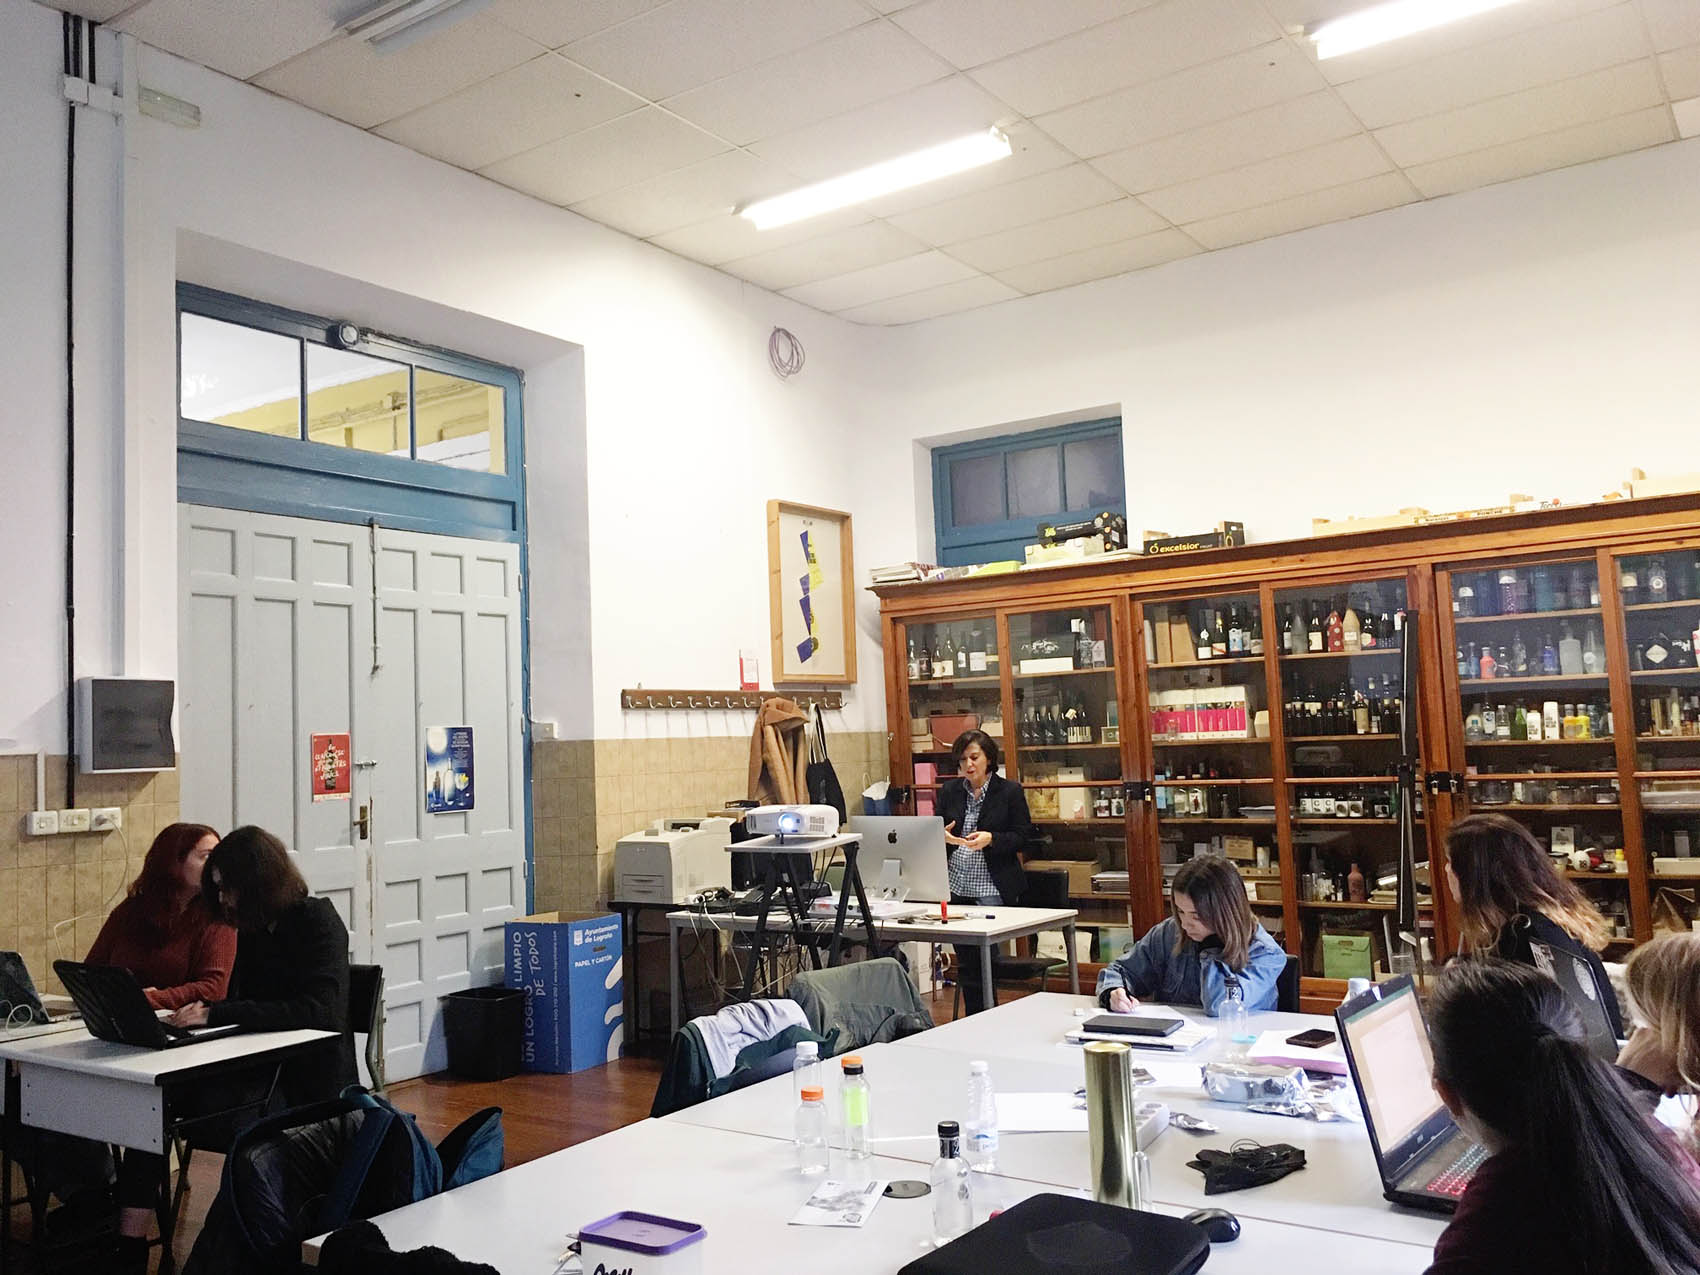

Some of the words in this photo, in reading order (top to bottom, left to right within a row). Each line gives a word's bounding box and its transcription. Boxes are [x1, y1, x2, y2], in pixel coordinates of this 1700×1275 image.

[1160, 543, 1200, 553] excelsior
[513, 931, 522, 982] LIMPIO
[524, 931, 542, 975] TODOS
[532, 978, 546, 996] DE
[525, 1042, 535, 1063] UN
